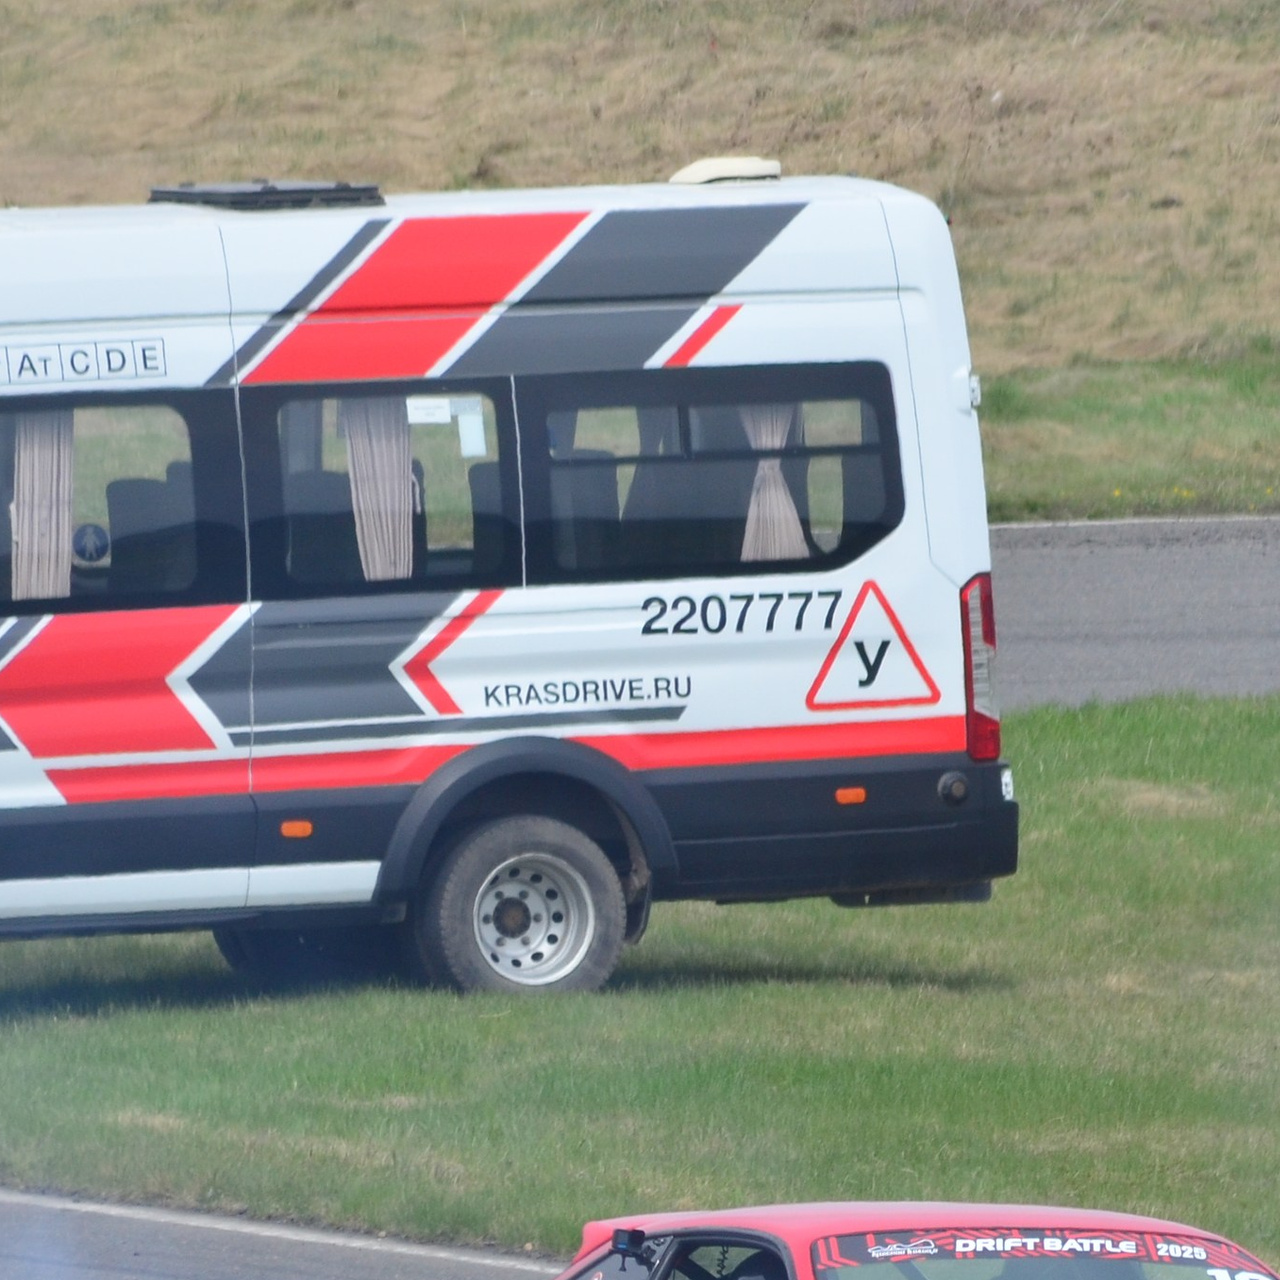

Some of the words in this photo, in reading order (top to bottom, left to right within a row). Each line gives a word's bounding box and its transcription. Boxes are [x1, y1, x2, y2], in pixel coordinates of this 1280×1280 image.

[640, 589, 843, 636] 2207777
[483, 675, 693, 708] KRASDRIVE.RU
[955, 1237, 1040, 1253] DRIFT
[1043, 1238, 1137, 1254] BATTLE
[1156, 1243, 1207, 1261] 2025
